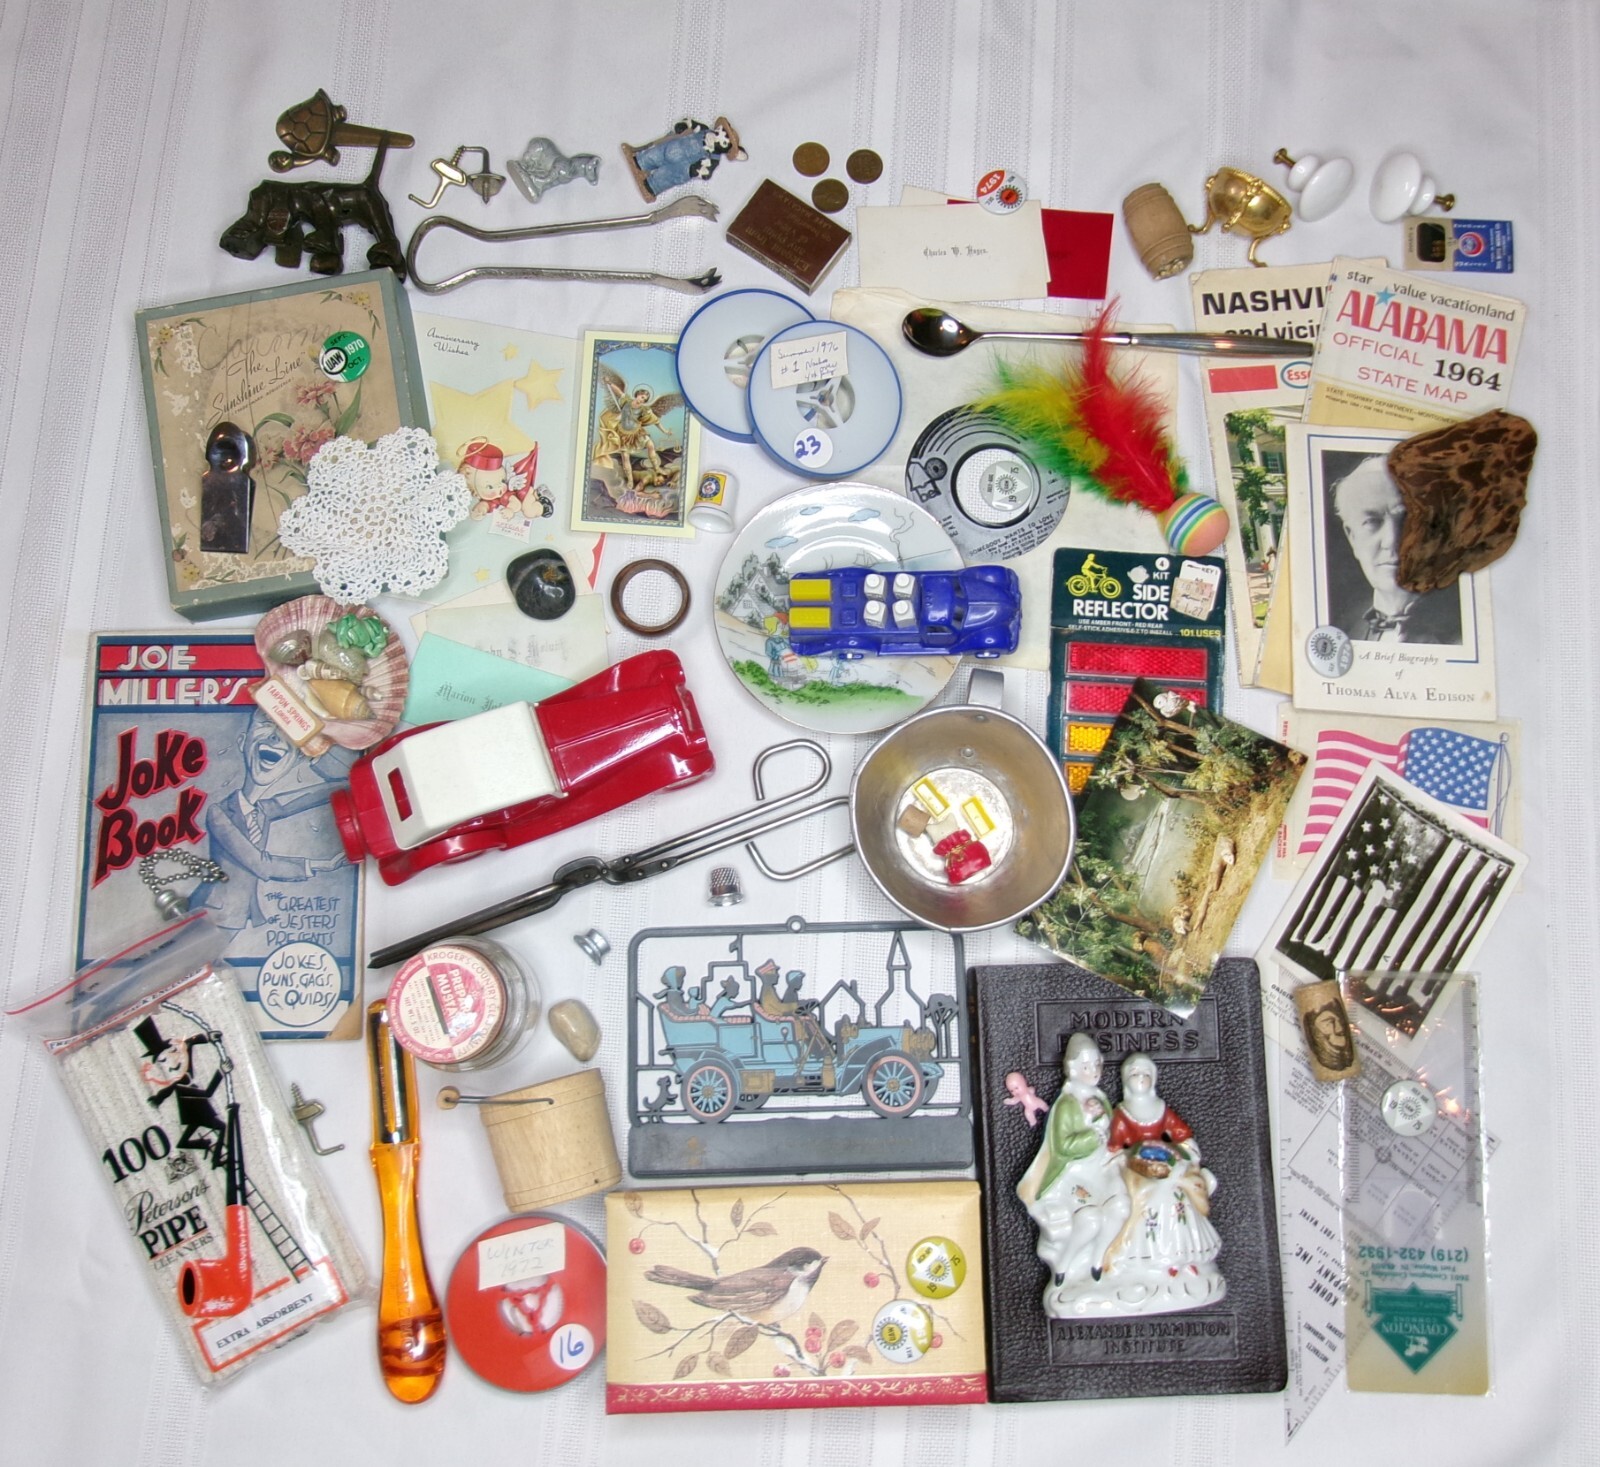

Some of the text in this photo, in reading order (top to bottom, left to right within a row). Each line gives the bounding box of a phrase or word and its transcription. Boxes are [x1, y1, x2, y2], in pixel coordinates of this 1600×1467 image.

[980, 173, 1001, 194] 1974
[1346, 268, 1374, 285] star
[1201, 286, 1328, 316] NASHVI
[1392, 281, 1517, 322] value vacationland
[1336, 289, 1508, 365] ALABAMA
[330, 333, 347, 346] SEPT.
[344, 339, 365, 355] 1970
[426, 327, 480, 351] Anniversary
[433, 341, 470, 356] Wishes
[816, 341, 839, 354] 1976
[325, 352, 344, 371] UAW
[348, 356, 365, 370] OCT.
[1333, 332, 1502, 392] OFFICIAL 1964
[1357, 366, 1469, 405] STATE MAP
[206, 379, 265, 430] Sunshine
[795, 434, 822, 460] 23
[1010, 467, 1019, 475] 75
[1008, 495, 1017, 503] 19
[968, 514, 1053, 557] SOMEBODY WANTS TO LOVE
[1152, 571, 1170, 580] KIT
[1132, 584, 1170, 601] SIDE
[1072, 599, 1169, 621] REFLECTOR
[1179, 628, 1221, 638] 101 USES
[119, 645, 197, 671] JOE
[1374, 652, 1395, 663] Brief
[1398, 652, 1440, 665] Biography
[1395, 668, 1404, 679] of
[101, 678, 248, 706] MILLER'S
[434, 681, 476, 705] Marion
[1321, 681, 1476, 703] THOMAS ALVA EDISON
[266, 684, 311, 732] TARPON SPRINGS
[272, 705, 291, 726] FLORIDA
[265, 891, 287, 902] THE
[277, 896, 341, 912] GREATEST
[267, 913, 341, 929] OF JESTERS
[266, 930, 334, 946] PRESENTS
[426, 951, 472, 966] KROGER'S
[470, 960, 497, 1001] COUNTRY
[1070, 1009, 1184, 1030] MODERN
[1413, 1119, 1423, 1130] 75
[102, 1124, 171, 1184] 100
[138, 1205, 209, 1259] PIPE
[1299, 1208, 1336, 1240] FORT WAYNE
[153, 1232, 214, 1271] CLEANERS
[487, 1238, 556, 1260] WINTER
[1295, 1242, 1313, 1265] INC.
[1358, 1246, 1425, 1260] 432-1932
[1431, 1246, 1469, 1262] (219)
[501, 1256, 544, 1278] 1972
[950, 1254, 961, 1266] 75
[926, 1282, 937, 1293] 19
[1308, 1278, 1339, 1308] KUHNE
[216, 1327, 250, 1349] EXTRA
[255, 1293, 314, 1330] ABSORBENT
[1057, 1321, 1231, 1342] ALEXANDER HAMILTON
[1381, 1322, 1448, 1335] COVINGTON
[887, 1326, 896, 1341] UAW
[560, 1329, 585, 1364] 16
[1103, 1339, 1186, 1355] INSTITUTE
